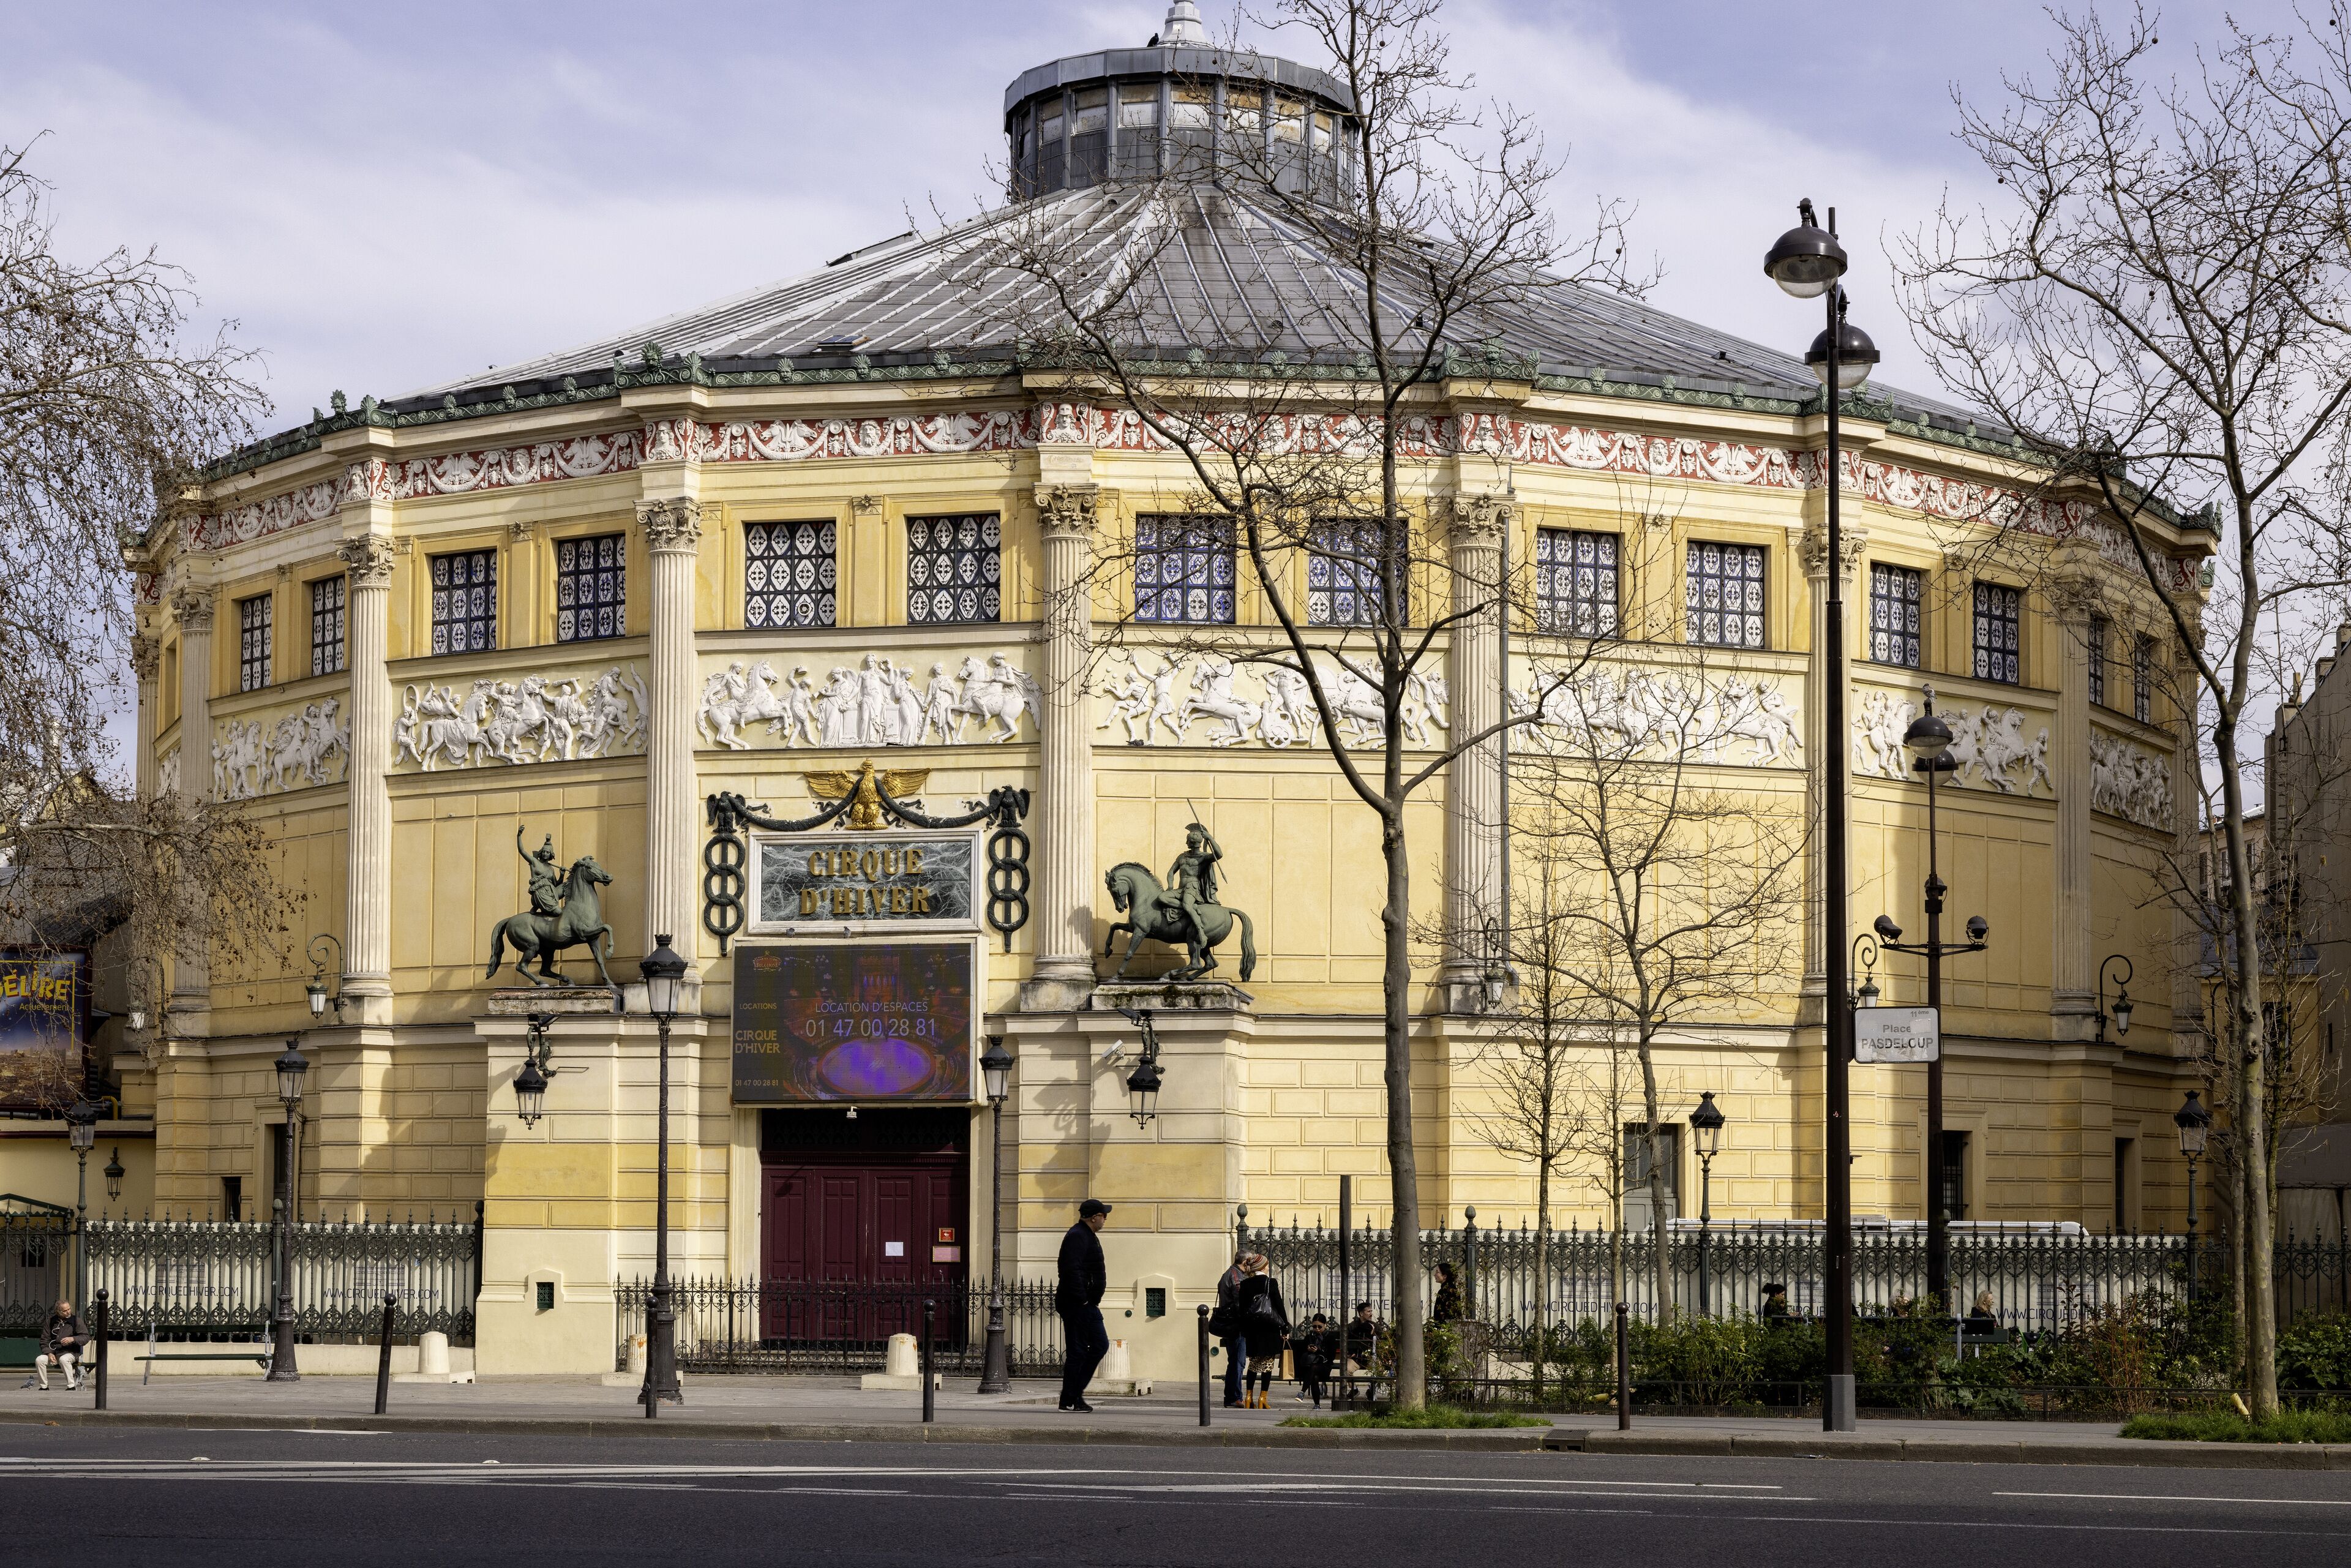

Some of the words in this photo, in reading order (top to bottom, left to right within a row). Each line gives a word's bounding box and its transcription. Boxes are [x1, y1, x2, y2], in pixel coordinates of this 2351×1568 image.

[808, 849, 922, 882] CIRQUE
[800, 887, 930, 914] D'HIVER
[816, 1002, 869, 1013] LOCATION
[872, 1001, 928, 1012] D'ESPACES
[806, 1019, 825, 1037] 01
[833, 1019, 854, 1037] 47
[860, 1019, 882, 1037] 00
[888, 1018, 909, 1036] 28
[916, 1018, 935, 1036] 81
[1883, 1024, 1911, 1033] Place
[735, 1030, 777, 1041] CIRQUE
[735, 1043, 780, 1054] D'HIVER
